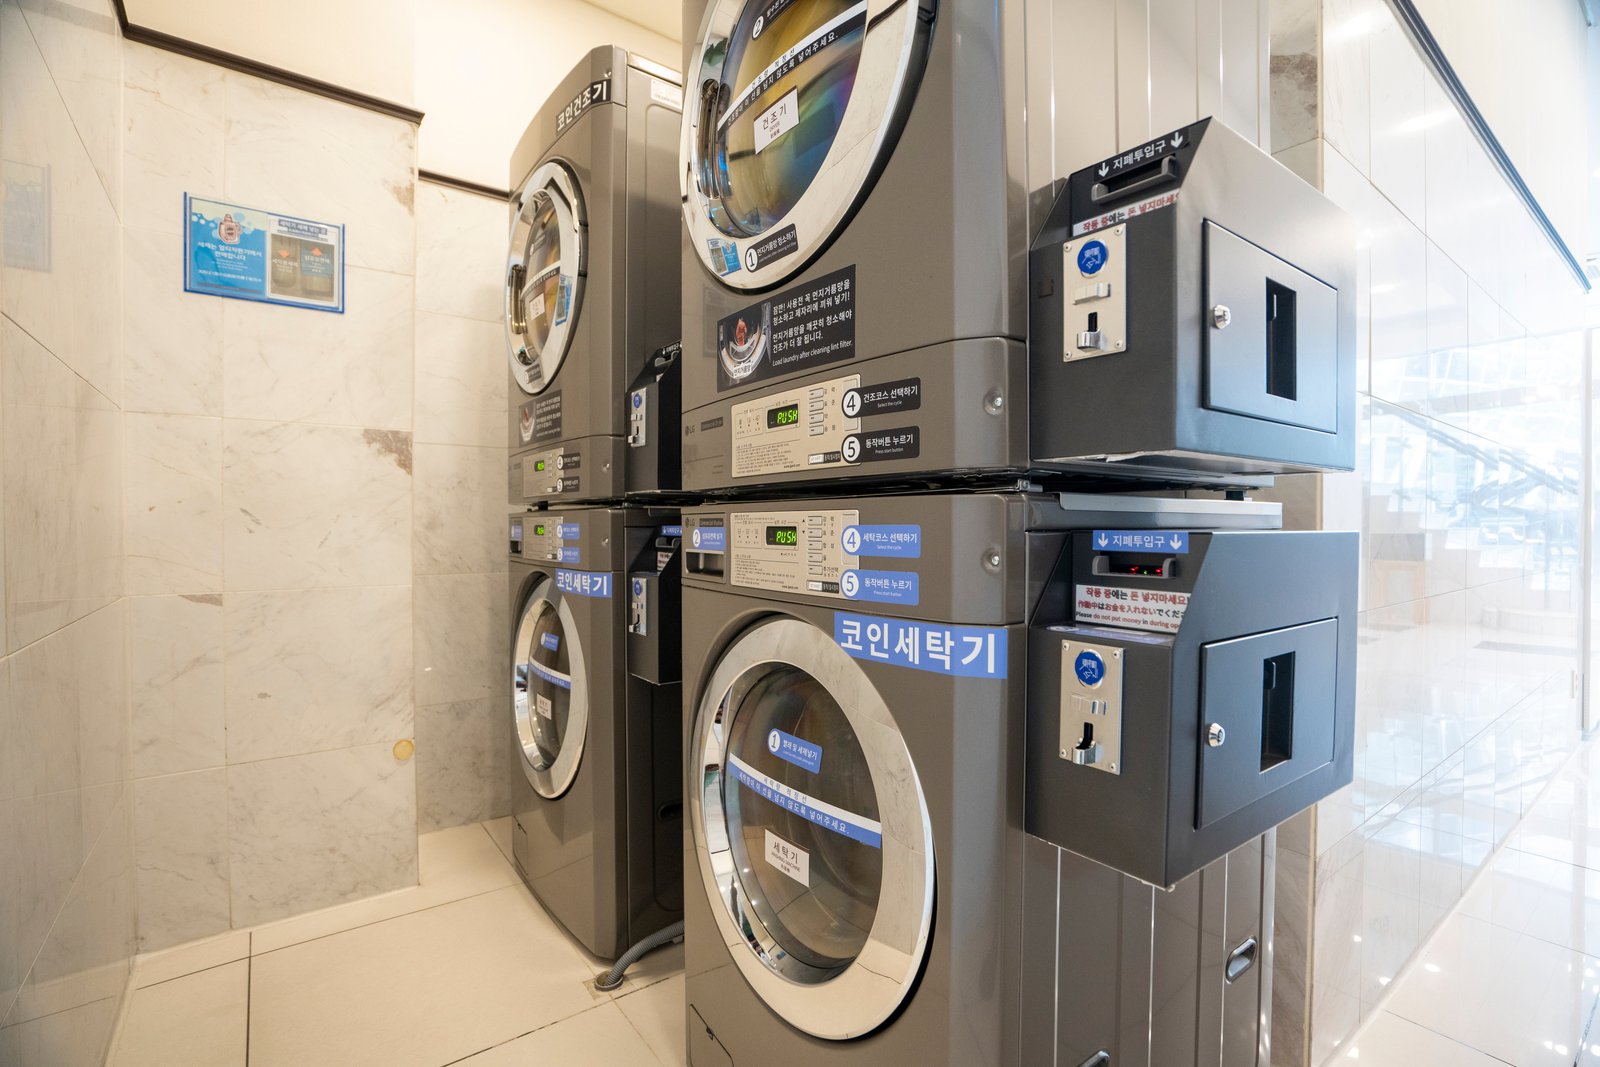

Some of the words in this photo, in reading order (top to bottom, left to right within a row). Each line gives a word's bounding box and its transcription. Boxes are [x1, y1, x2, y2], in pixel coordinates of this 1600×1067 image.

[798, 31, 838, 62] 넣어주세요.
[557, 81, 607, 132] 코인건조기
[763, 103, 787, 130] 건조기
[1113, 140, 1166, 169] 지폐투입구
[1083, 219, 1098, 232] 작동
[1101, 212, 1125, 227] 중에는
[1128, 207, 1136, 217] 돈
[787, 296, 804, 309] 사용전
[812, 279, 850, 301] 먼지거름망을
[773, 311, 794, 326] 청소하고
[795, 302, 819, 318] 제자리에
[835, 291, 850, 305] 넣기!
[773, 324, 804, 343] 먼지거름망을
[826, 309, 852, 326] 청소해야
[773, 341, 788, 354] 건조가
[790, 338, 795, 347] 더
[797, 336, 802, 347] 잘
[773, 358, 782, 366] Load
[783, 354, 799, 364] laundry
[800, 350, 810, 359] after
[810, 345, 831, 356] cleaning
[831, 343, 839, 351] lint
[847, 394, 856, 411] 4
[863, 390, 889, 403] 건조코스
[890, 385, 918, 398] 선택하기
[776, 409, 798, 424] PUSH
[847, 441, 856, 458] 5
[865, 436, 891, 449] 동작버튼
[893, 434, 914, 445] 누르기
[776, 531, 797, 543] PUSH
[847, 532, 856, 548] 4
[863, 532, 889, 542] 세탁코스
[890, 532, 917, 543] 선택하기
[1113, 535, 1165, 548] 지폐투입구
[557, 572, 608, 596] 코인세탁기
[846, 575, 854, 592] 5
[864, 577, 890, 589] 동작버튼
[891, 580, 912, 591] 누르기
[1086, 587, 1101, 598] 작동
[1104, 589, 1128, 600] 중에는
[1130, 591, 1139, 601] 돈
[1122, 617, 1140, 625] money
[1149, 619, 1169, 628] during
[840, 620, 995, 673] 코인세탁기
[798, 746, 817, 760] 세제넣기
[775, 792, 785, 806] 넘지
[788, 799, 806, 816] 않도록
[810, 810, 849, 834] 넣어주세요.
[773, 842, 797, 864] 세탁기
